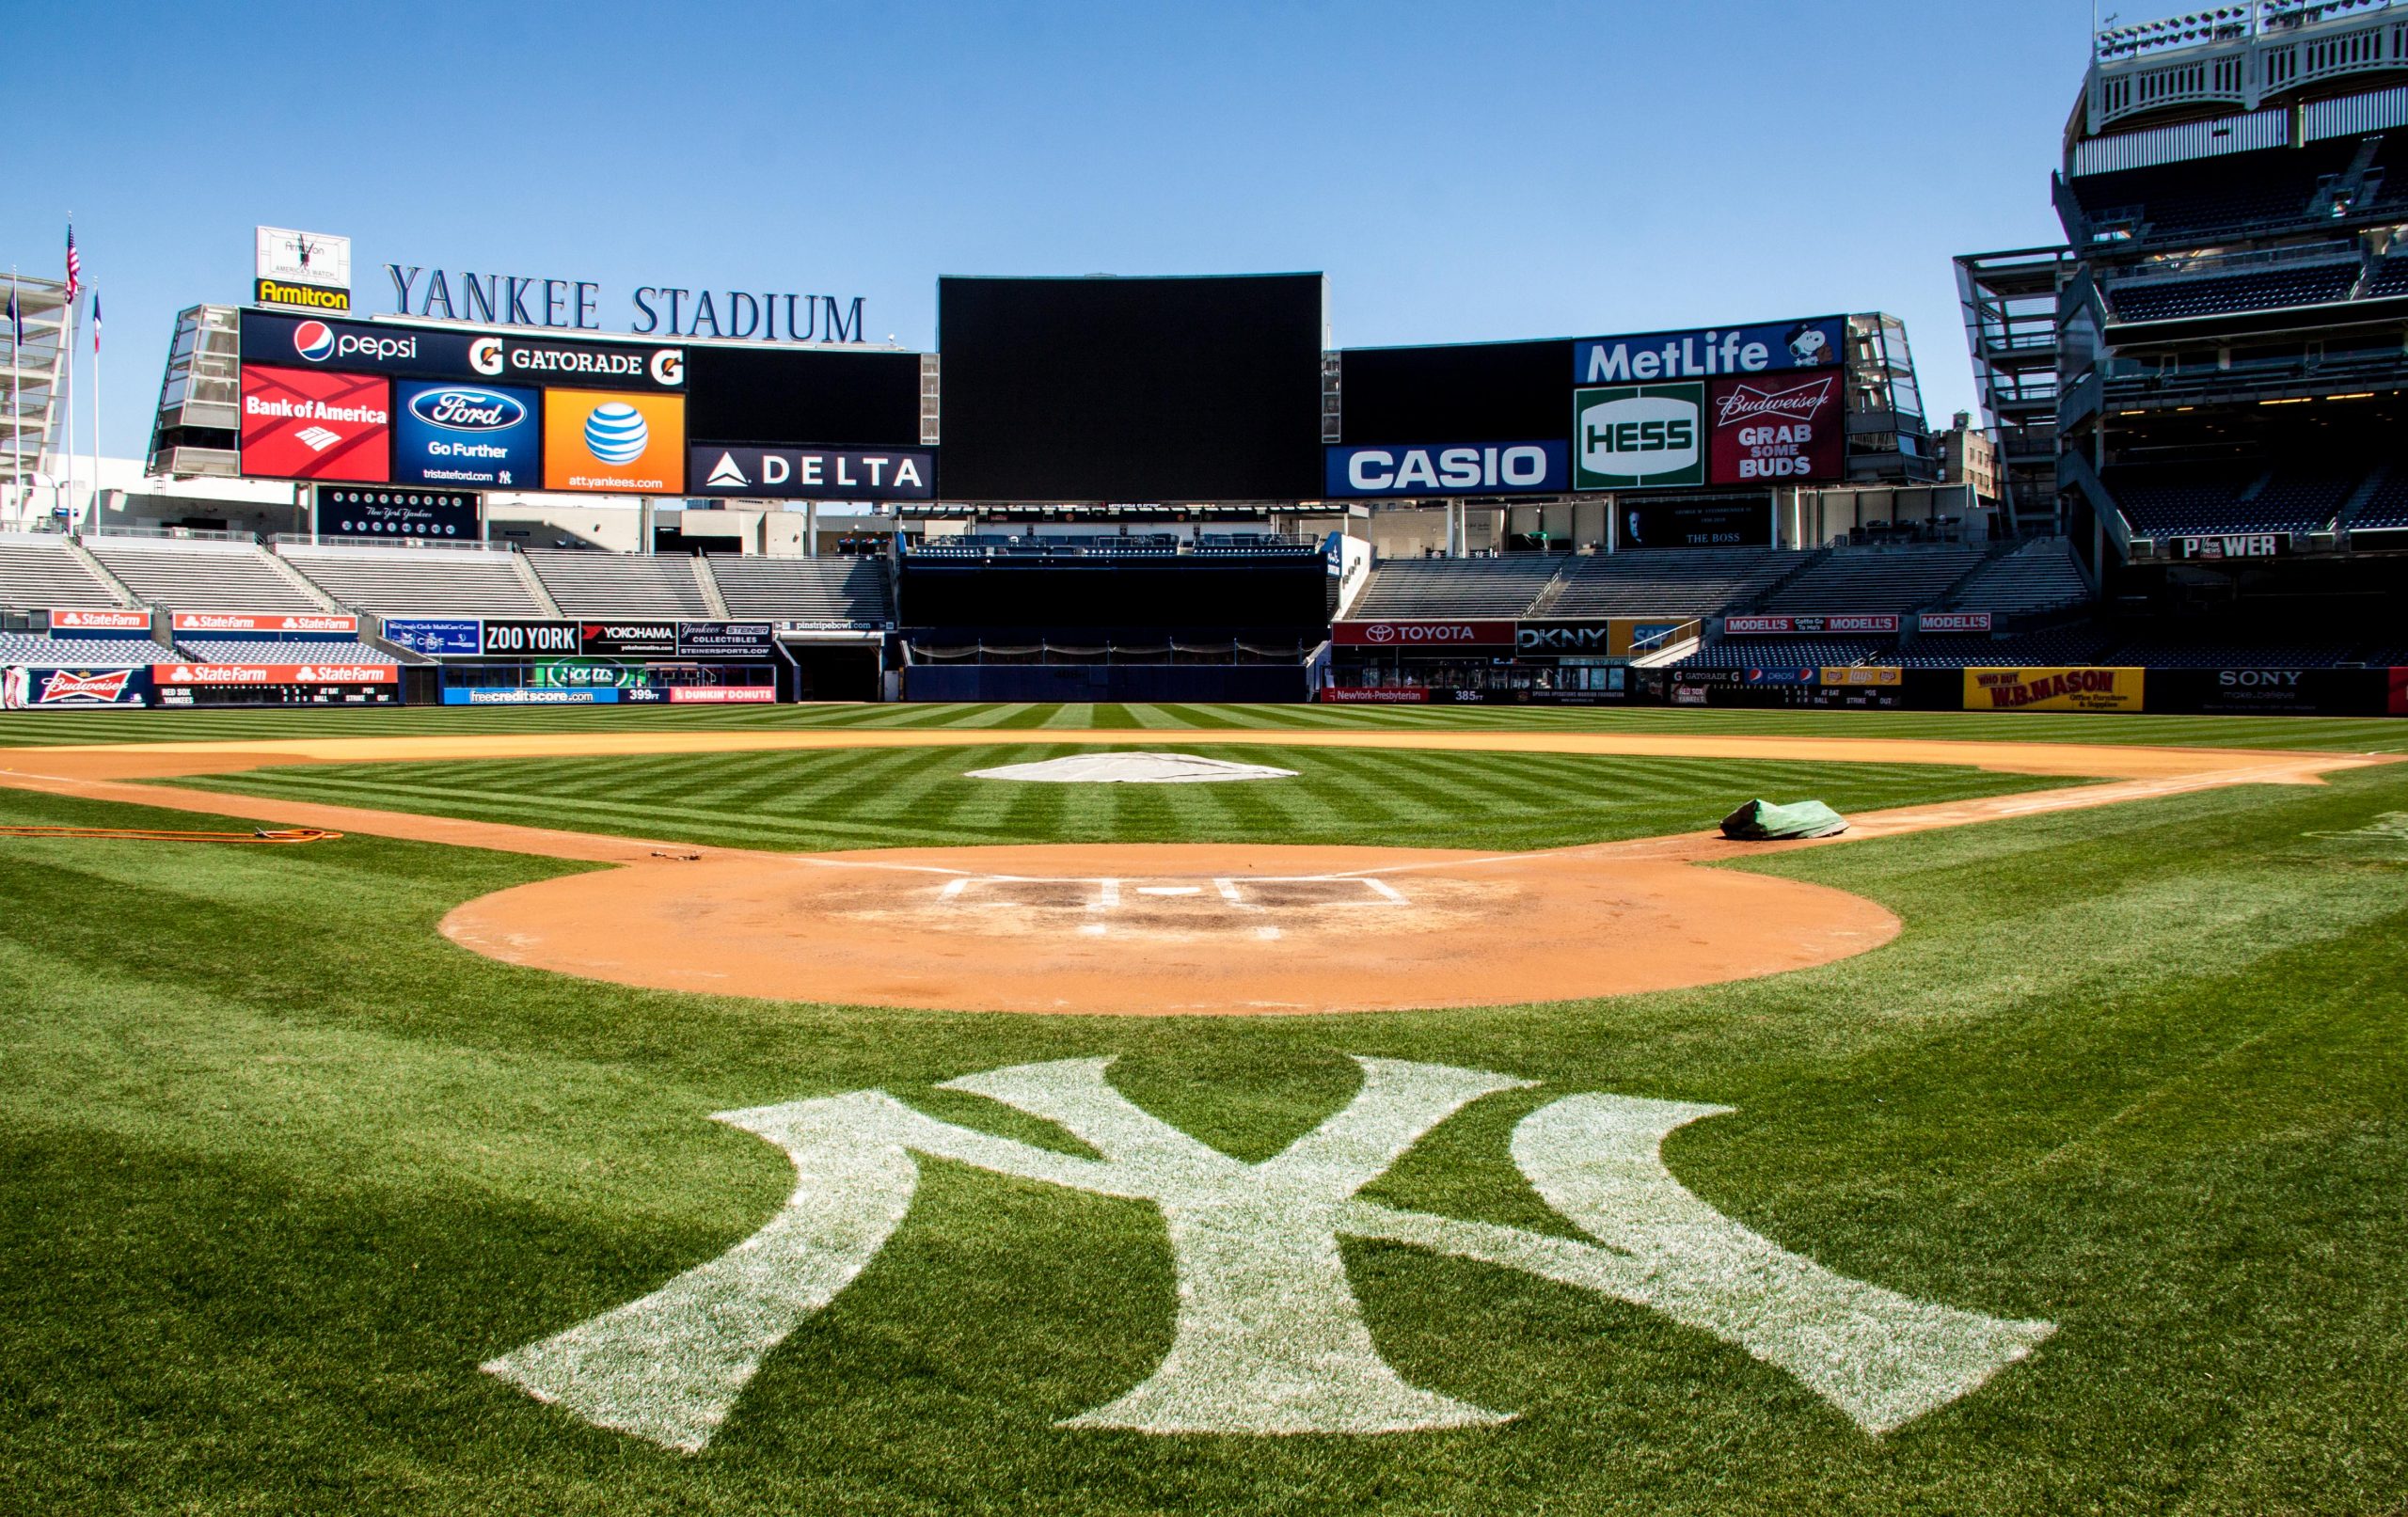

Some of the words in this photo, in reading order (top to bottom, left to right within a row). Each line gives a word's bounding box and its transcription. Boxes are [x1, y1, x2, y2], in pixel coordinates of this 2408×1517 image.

[261, 280, 349, 309] Armitron
[384, 263, 600, 331] YANKEE
[632, 285, 868, 344] STADIUM
[338, 336, 417, 361] pepsi
[512, 350, 642, 375] GATORADE
[1587, 330, 1768, 383] MetLife
[246, 395, 294, 416] Bank
[294, 400, 313, 418] of
[314, 402, 388, 424] America
[432, 393, 504, 426] Ford
[1716, 391, 1829, 416] Budweiser
[1587, 419, 1693, 454] HESS
[1737, 424, 1813, 446] GRAB
[429, 441, 452, 457] Go
[453, 443, 509, 459] Further
[1751, 444, 1799, 458] SOME
[762, 454, 923, 487] DELTA
[1348, 446, 1546, 490] CASIO
[1739, 455, 1812, 479] BUDS
[423, 468, 493, 482] tristateford.com
[568, 475, 663, 489] att.yankees.com
[365, 506, 383, 515] New
[383, 507, 402, 520] York
[402, 508, 433, 521] Yankees
[1686, 533, 1707, 544] THE
[1711, 532, 1740, 543] BOSS
[796, 621, 871, 631] pinstripebowl.com
[1729, 618, 1788, 632] MODELL'S
[1830, 617, 1892, 630] MODELL'S
[1921, 615, 1988, 629] MODELL'S
[486, 626, 524, 650] ZOO
[526, 626, 577, 650] YORK
[604, 626, 673, 639] YOKOHAMA
[681, 623, 721, 638] Yankees
[727, 626, 768, 635] STEINER
[1398, 626, 1475, 640] TOYOTA
[1518, 627, 1608, 648] DKNY
[1685, 672, 1728, 681] GATORADE
[1767, 671, 1795, 681] pepsi
[1977, 673, 1998, 687] WHO
[2000, 673, 2019, 684] BUT
[2219, 671, 2303, 686] SONY
[41, 677, 129, 692] Budweiser
[161, 687, 176, 696] RED
[177, 687, 191, 696] SOX
[1990, 670, 2116, 707] W.B.MASON
[471, 690, 594, 703] freecreditscore.com
[684, 689, 727, 700] DUNKIN'
[728, 689, 772, 700] DONUTS
[1337, 690, 1421, 703] NewYork-Presbyterian
[2222, 691, 2296, 700] make.believe
[2087, 701, 2118, 709] Supplies
